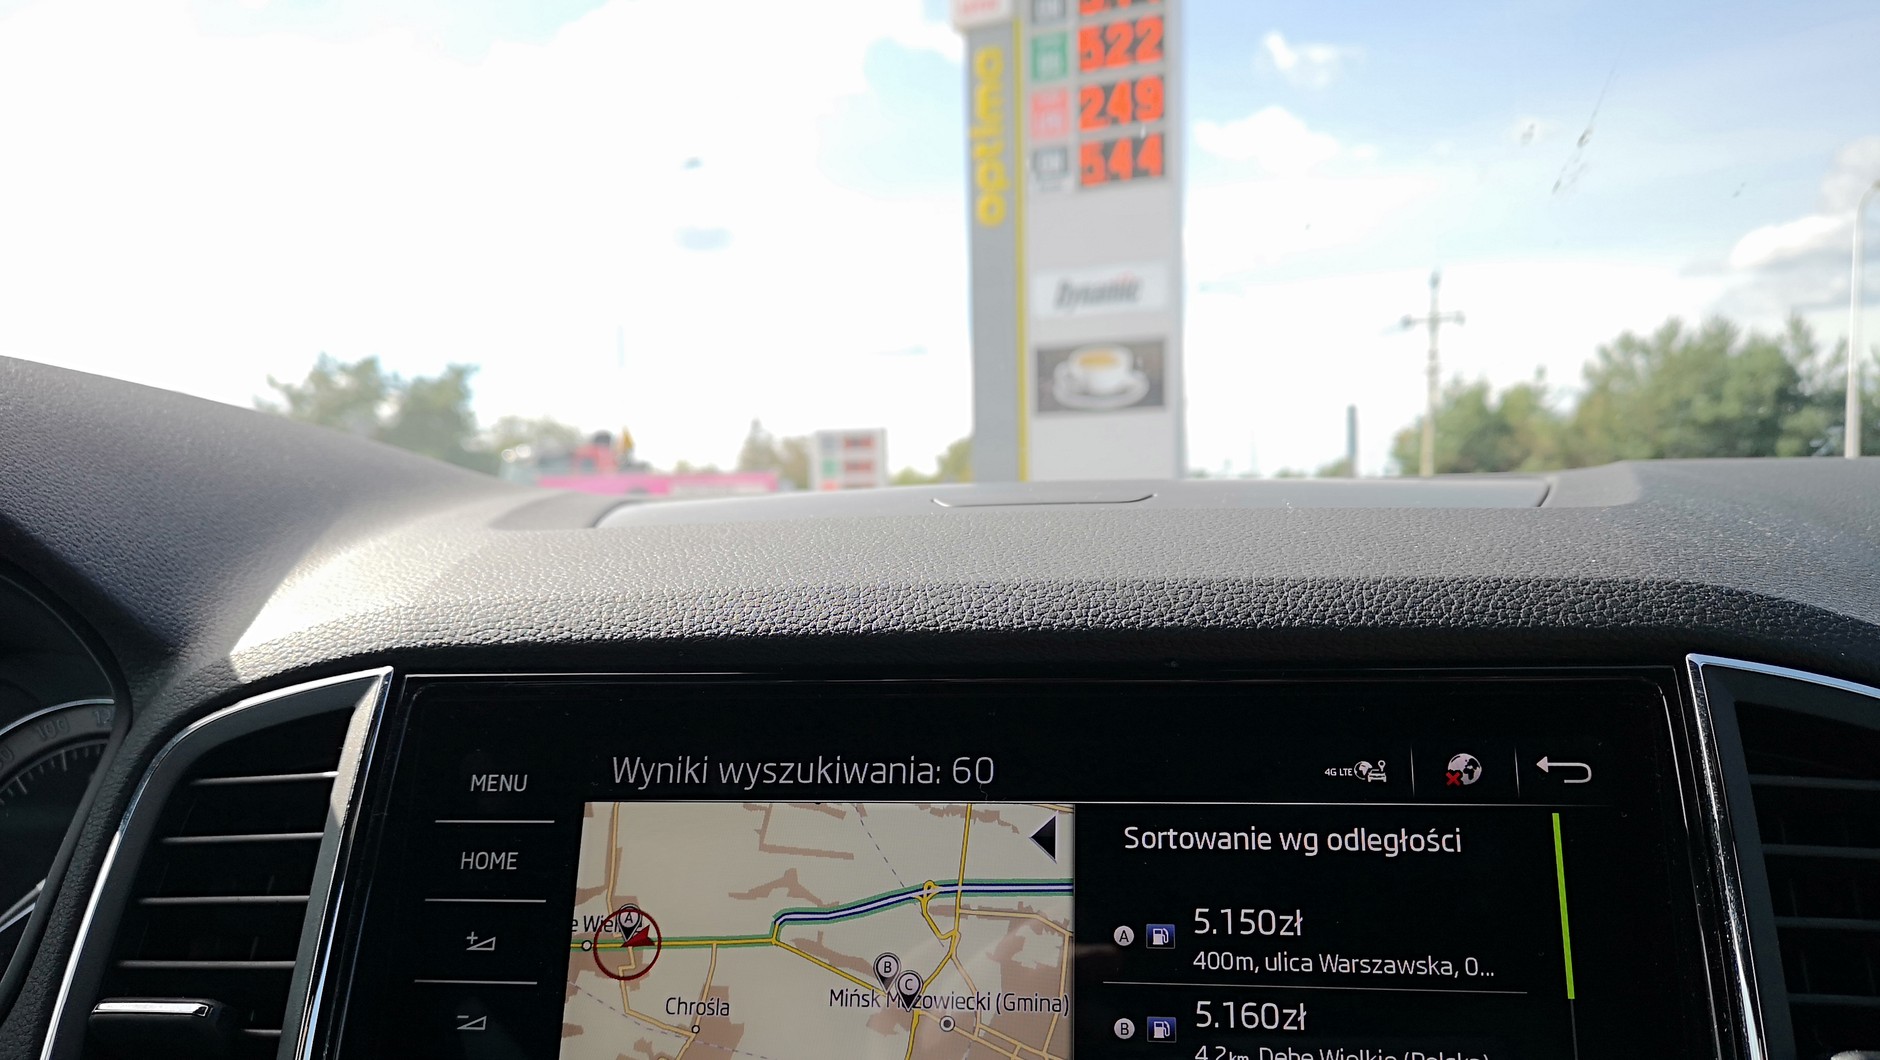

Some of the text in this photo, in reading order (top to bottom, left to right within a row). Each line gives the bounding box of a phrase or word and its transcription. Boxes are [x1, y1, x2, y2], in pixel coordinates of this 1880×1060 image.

[1078, 15, 1164, 72] 522
[1079, 75, 1164, 131] 249
[970, 46, 1008, 227] optima
[1079, 133, 1164, 187] 544
[470, 774, 528, 792] MENU
[612, 755, 994, 790] Wyniki wyszukiwania: 60
[1324, 767, 1353, 777] 4G LTE
[1124, 826, 1462, 857] Sortowanie wg odległości
[460, 851, 519, 870] HOME
[1119, 929, 1130, 943] A
[1194, 908, 1303, 936] 5.150zł
[882, 961, 892, 974] B
[1193, 951, 1259, 973] 400m,
[1265, 951, 1313, 972] ulica
[1319, 953, 1459, 979] Warszawska,
[904, 978, 914, 991] C
[665, 997, 730, 1017] Chrośla
[829, 988, 1070, 1016] Mińsk Mzowiecki (Gmina)
[1196, 1000, 1307, 1031] 5.160zł
[1119, 1022, 1130, 1036] B
